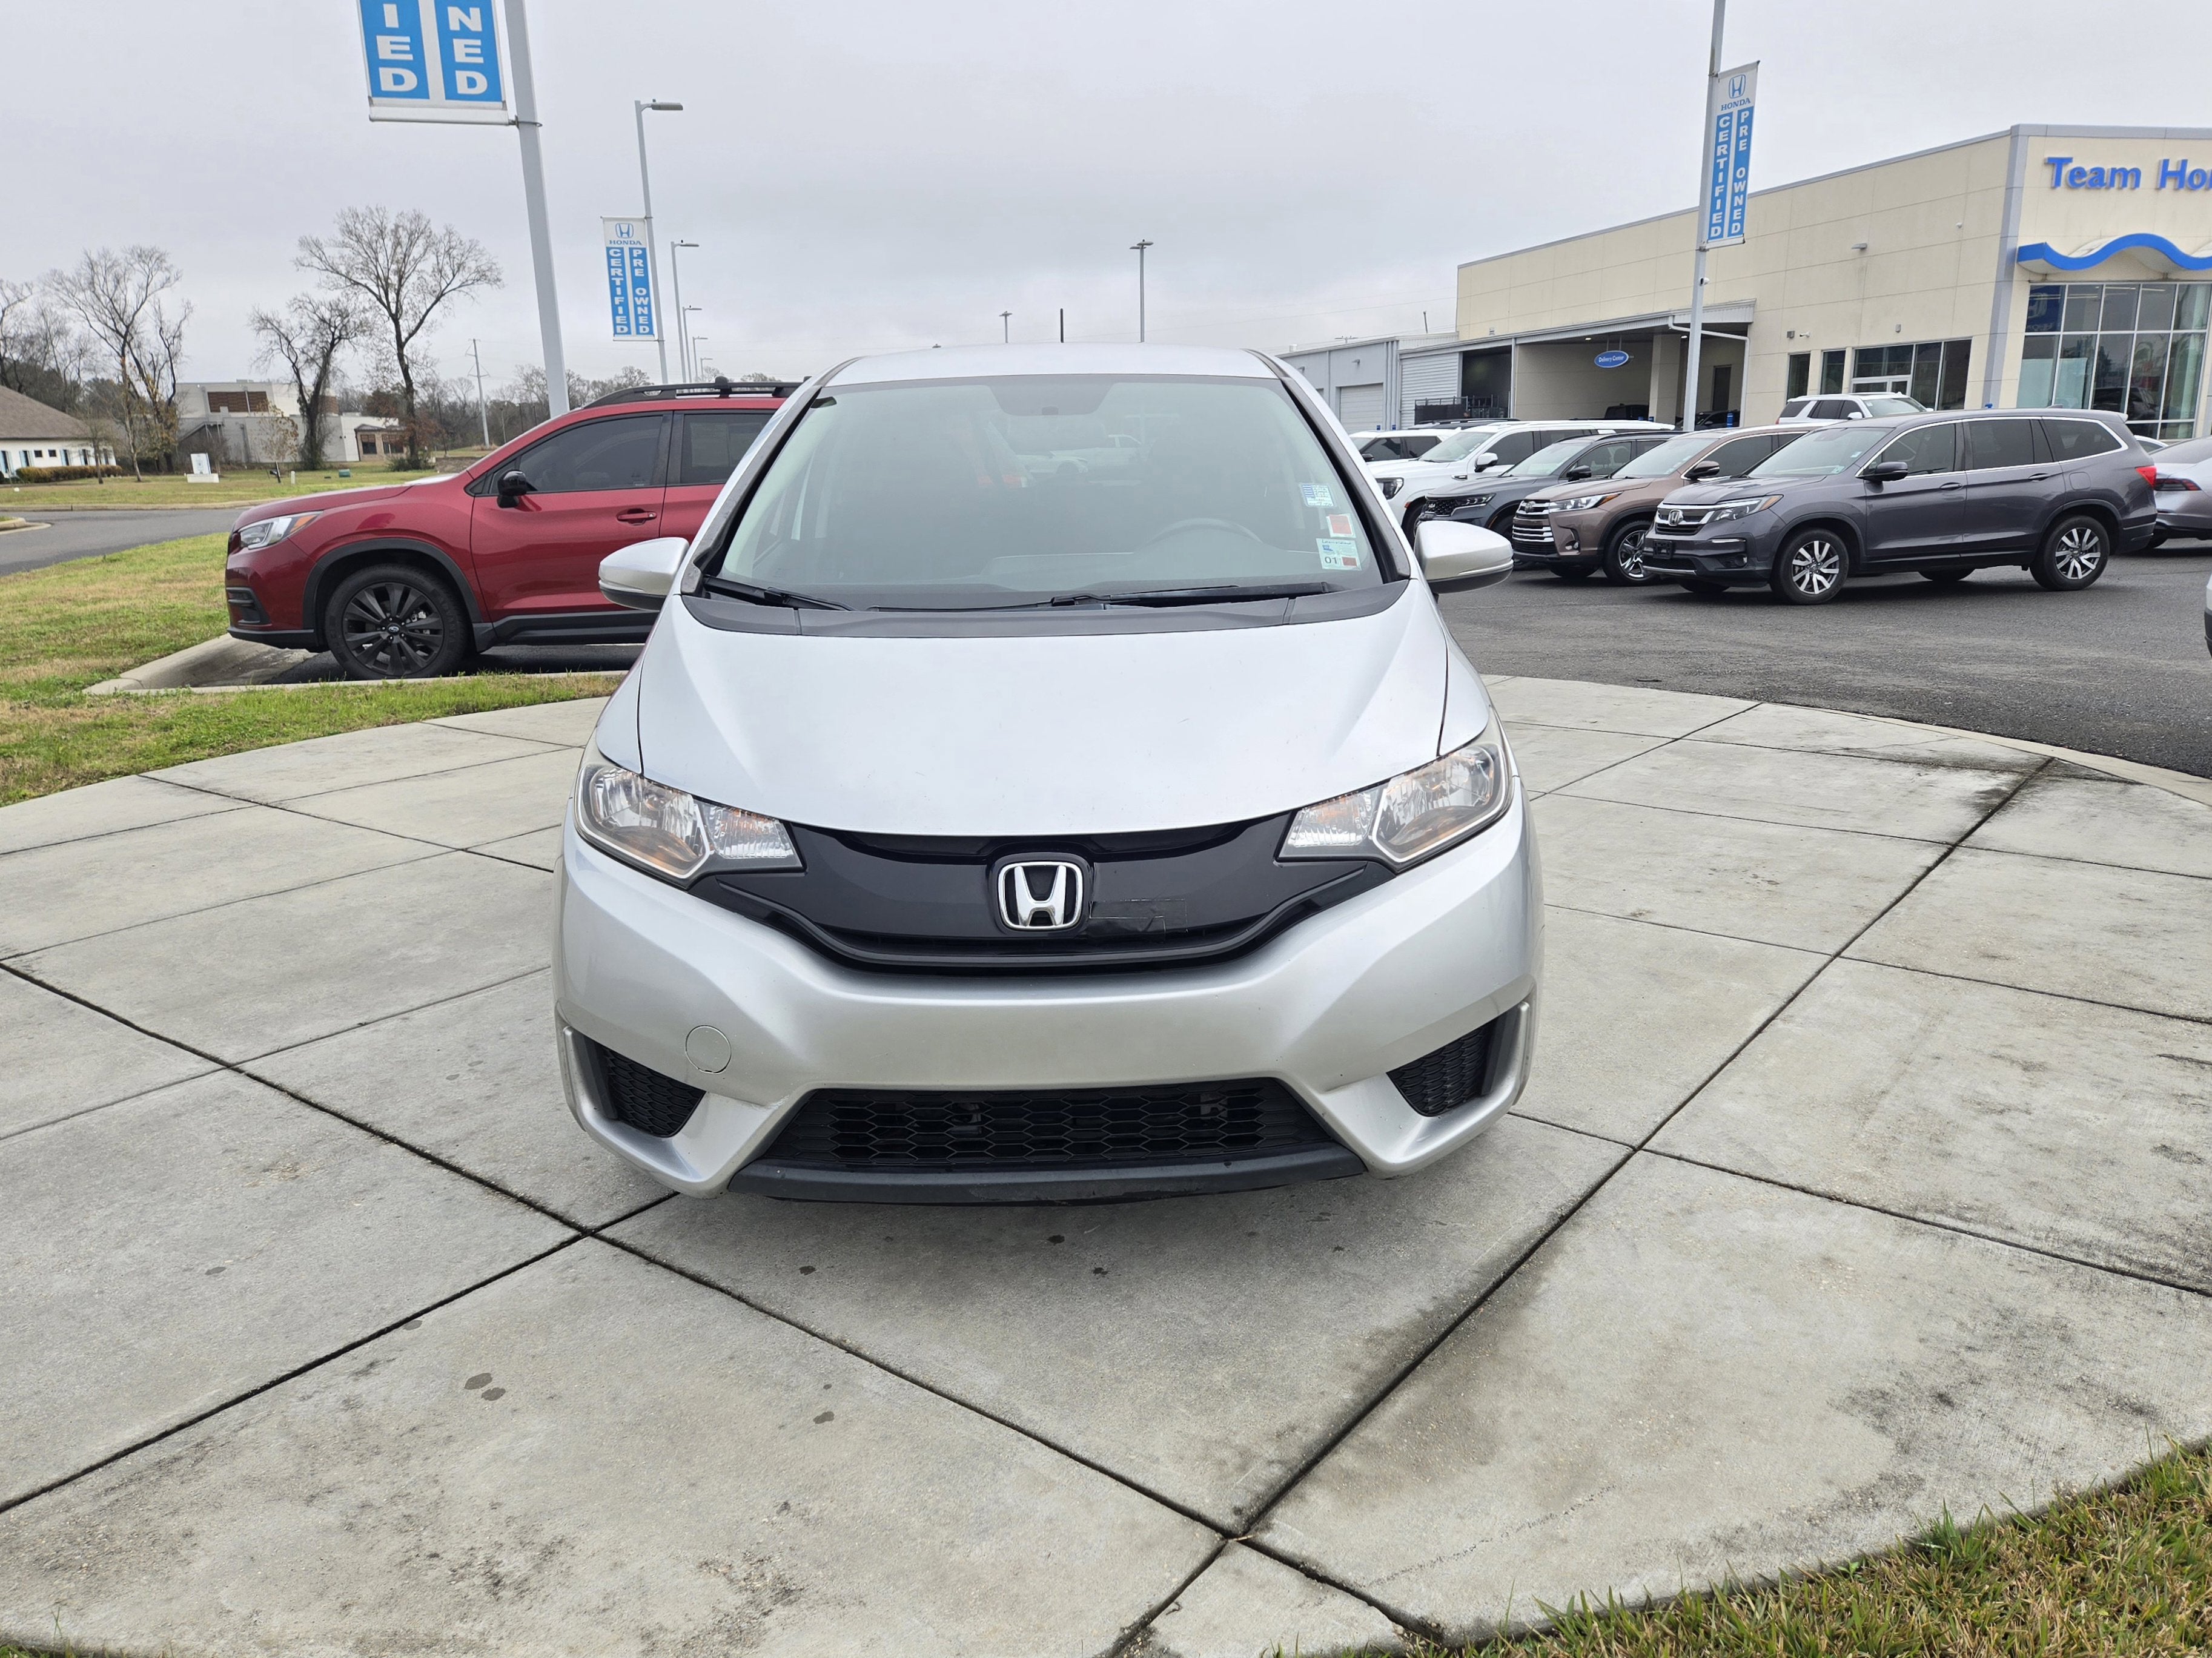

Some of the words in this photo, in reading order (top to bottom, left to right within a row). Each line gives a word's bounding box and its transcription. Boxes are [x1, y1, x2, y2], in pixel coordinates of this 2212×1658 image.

[1721, 98, 1751, 111] HONDA
[1738, 110, 1750, 151] PRE
[1710, 116, 1730, 237] CERTIFIED
[2044, 157, 2142, 189] Team
[2159, 159, 2212, 190] Ho
[1731, 167, 1746, 234] OWNED
[632, 249, 644, 277] PRE
[609, 248, 629, 334] CERTIFIED
[634, 287, 650, 333] OWNED
